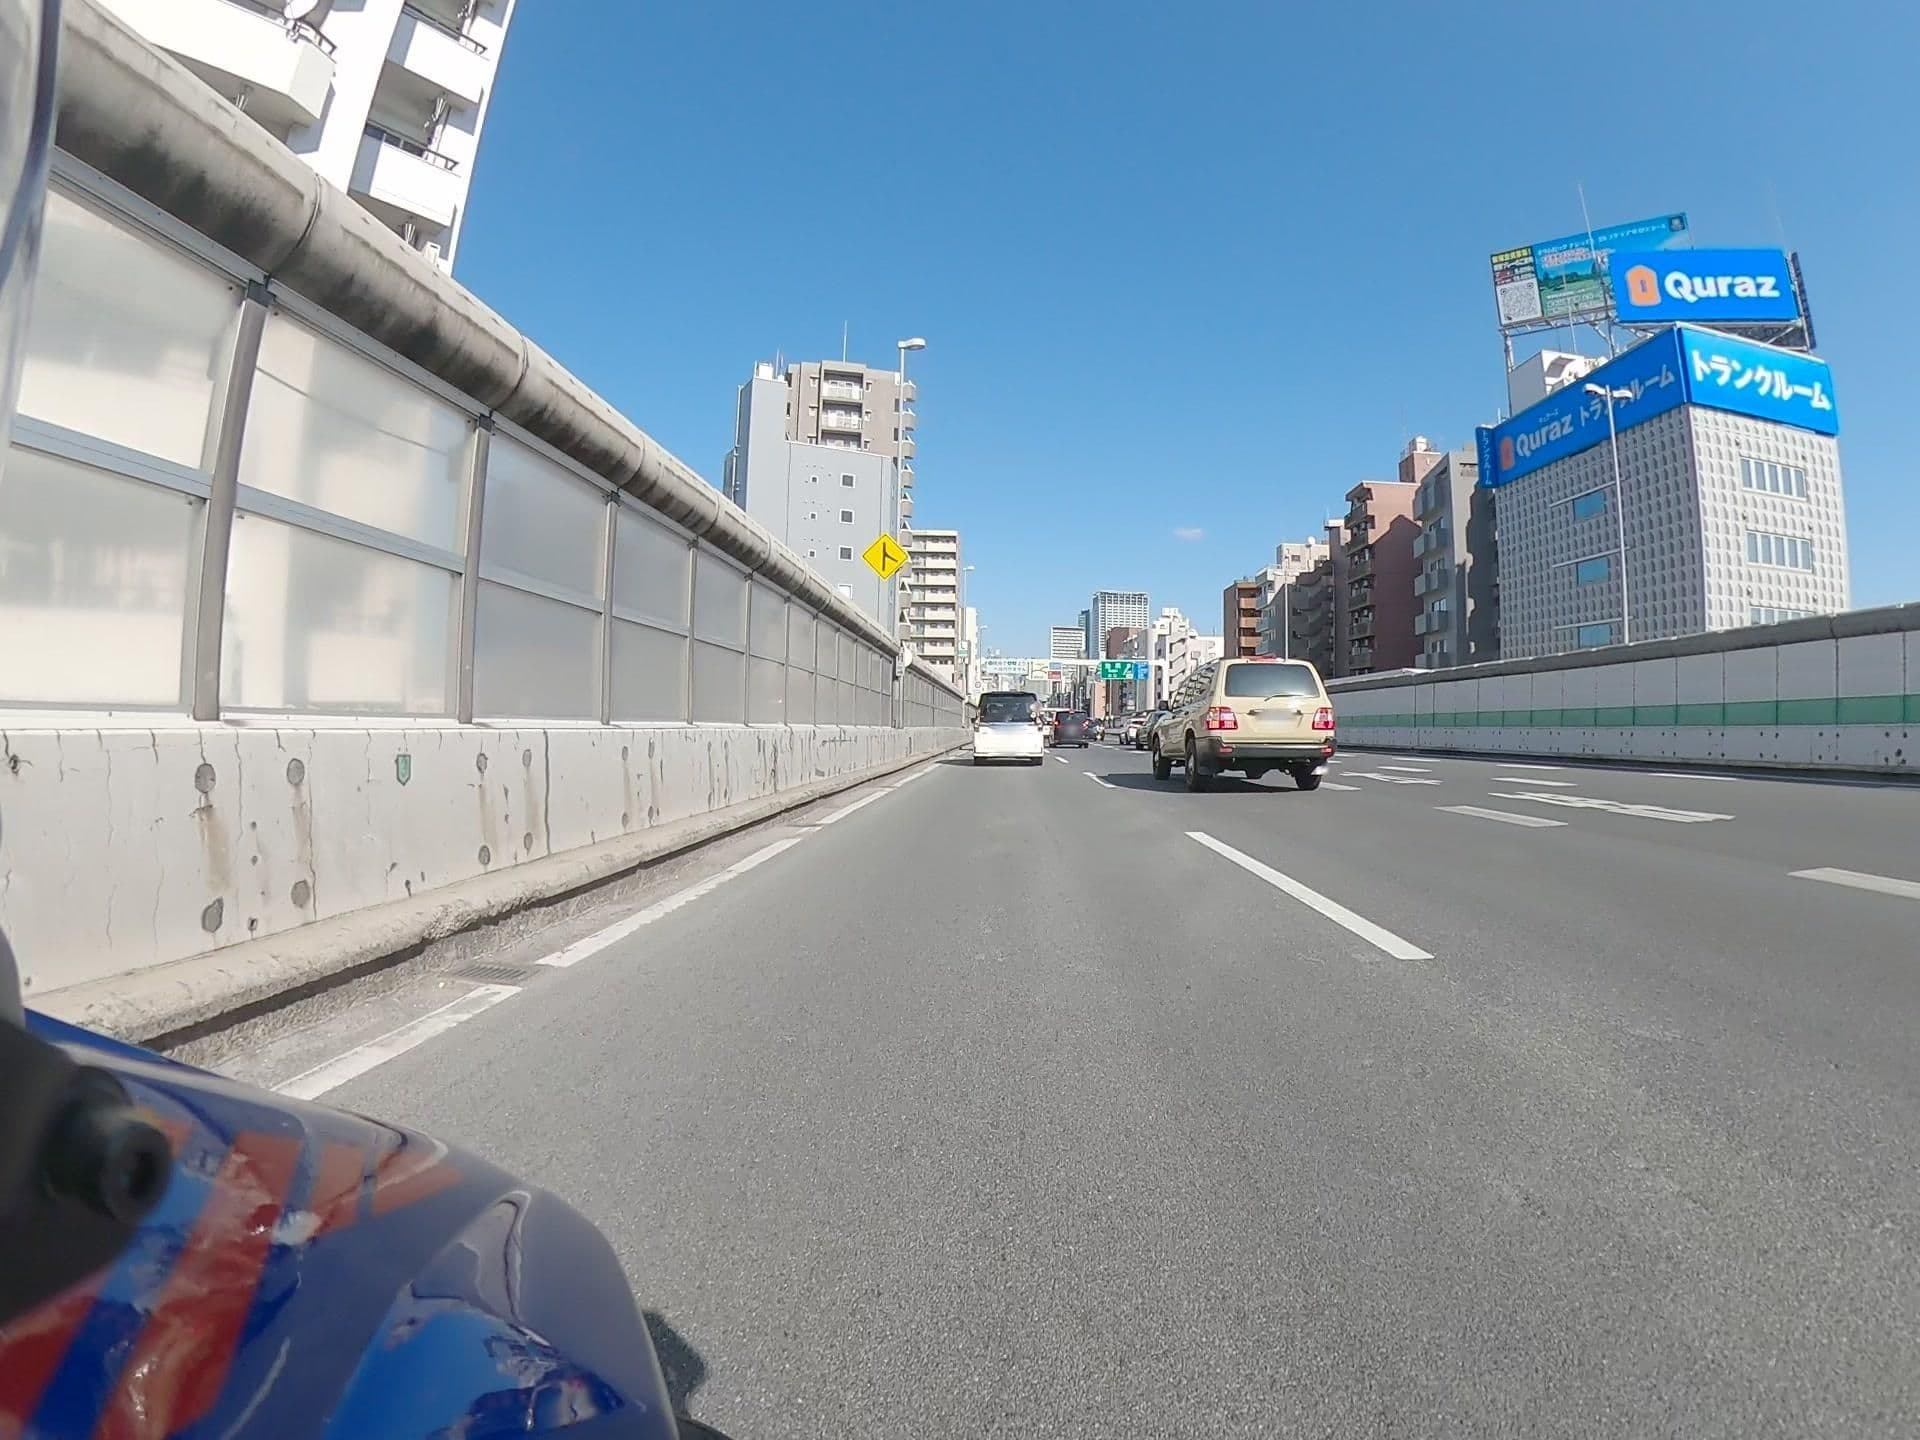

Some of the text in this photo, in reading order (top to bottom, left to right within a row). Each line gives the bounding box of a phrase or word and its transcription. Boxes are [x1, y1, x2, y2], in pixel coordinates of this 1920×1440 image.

[1664, 271, 1780, 302] Quraz
[1692, 350, 1831, 410] トランクルーム
[1516, 413, 1574, 457] Quraz
